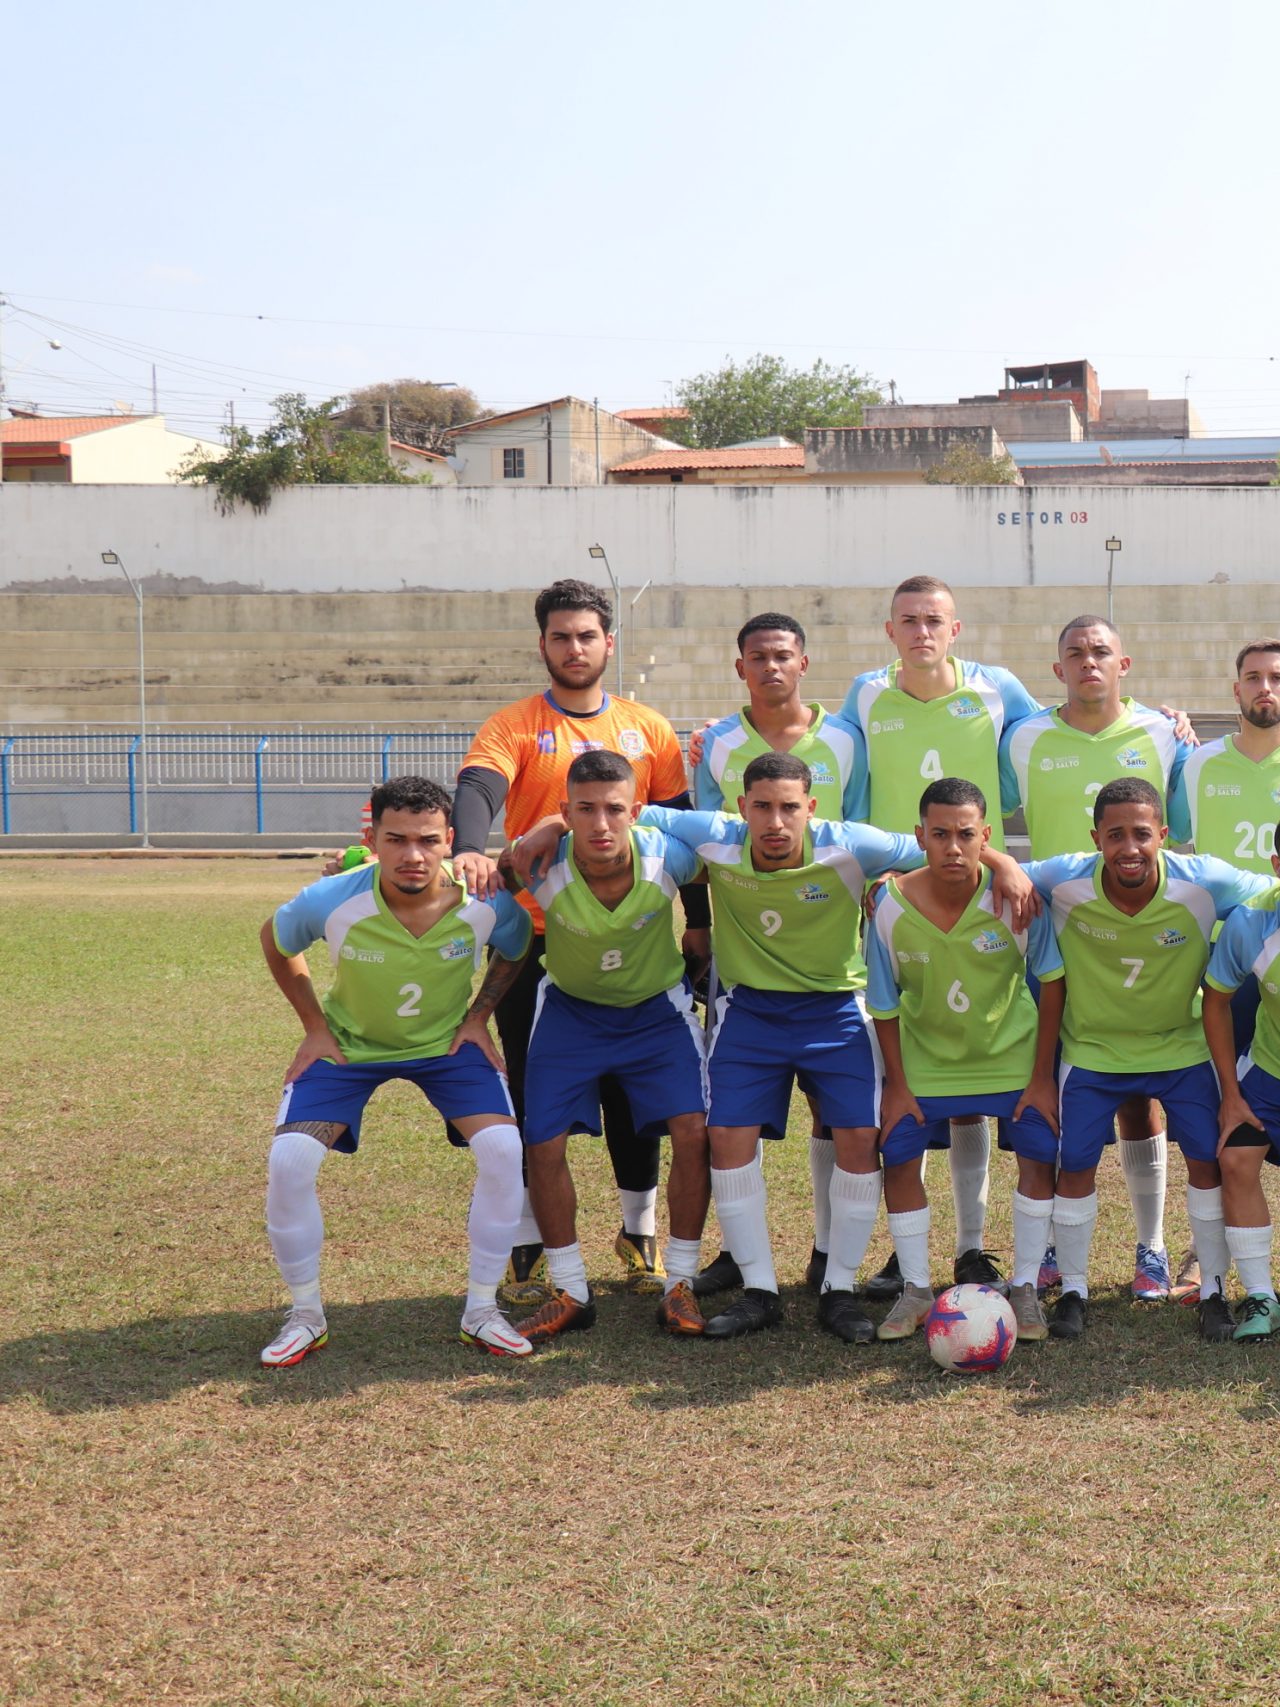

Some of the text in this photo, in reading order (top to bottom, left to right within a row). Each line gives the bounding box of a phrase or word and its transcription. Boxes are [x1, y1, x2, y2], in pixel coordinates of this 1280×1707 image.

[997, 511, 1088, 526] SETOR 03
[920, 749, 944, 781] 4
[1234, 821, 1277, 860] 20
[804, 893, 829, 901] Salto
[760, 909, 783, 937] 9
[449, 946, 473, 958] Salto
[983, 940, 1008, 951] Salto
[357, 954, 385, 964] SALTO
[601, 949, 622, 972] 8
[1120, 957, 1145, 989] 7
[396, 983, 423, 1017] 2
[947, 979, 970, 1013] 6
